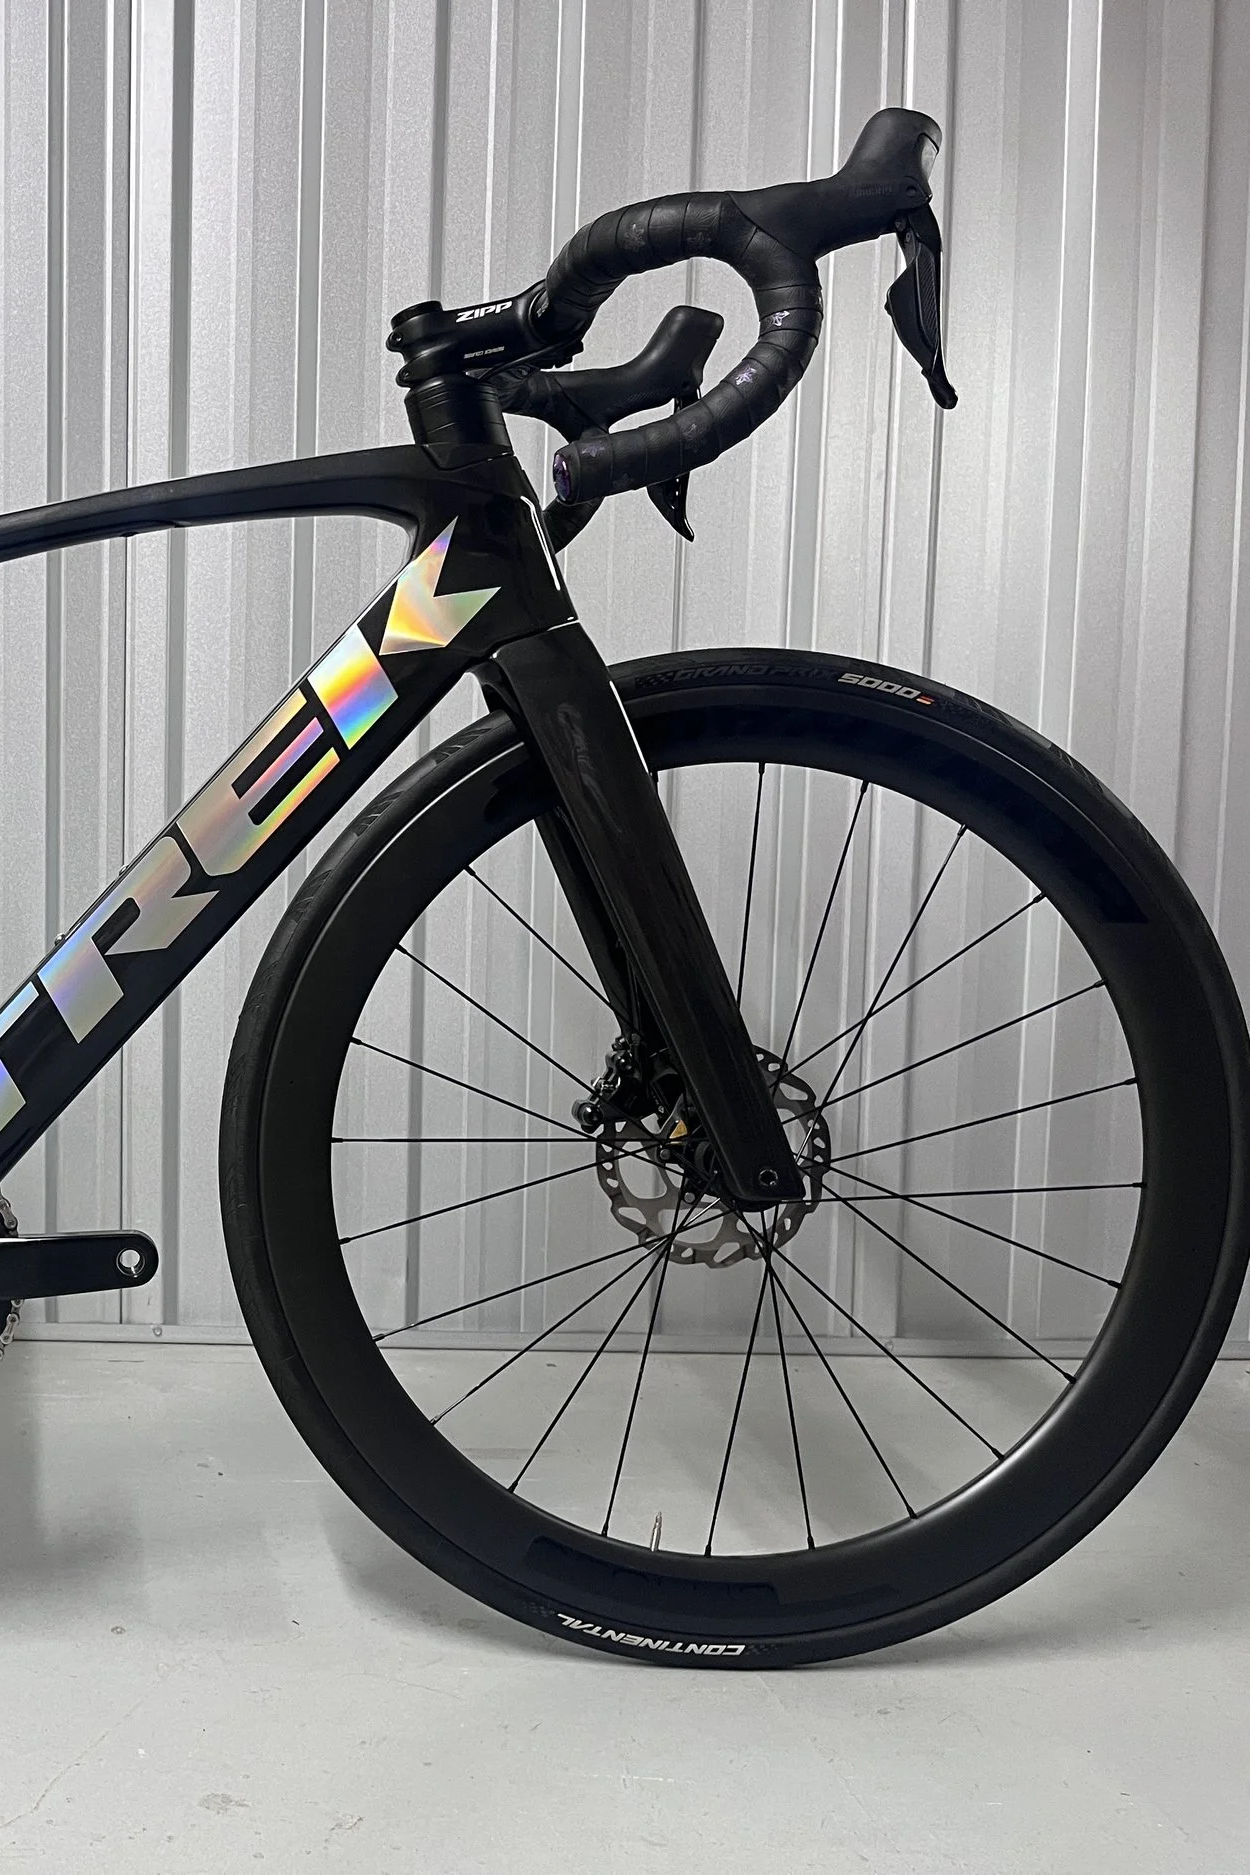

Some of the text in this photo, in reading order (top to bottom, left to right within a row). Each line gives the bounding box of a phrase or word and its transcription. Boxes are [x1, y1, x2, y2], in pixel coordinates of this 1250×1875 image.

[455, 300, 513, 323] ZIPP
[674, 664, 767, 681] GRAND
[837, 672, 922, 699] 5000
[557, 1612, 747, 1657] CONTINENTAL
